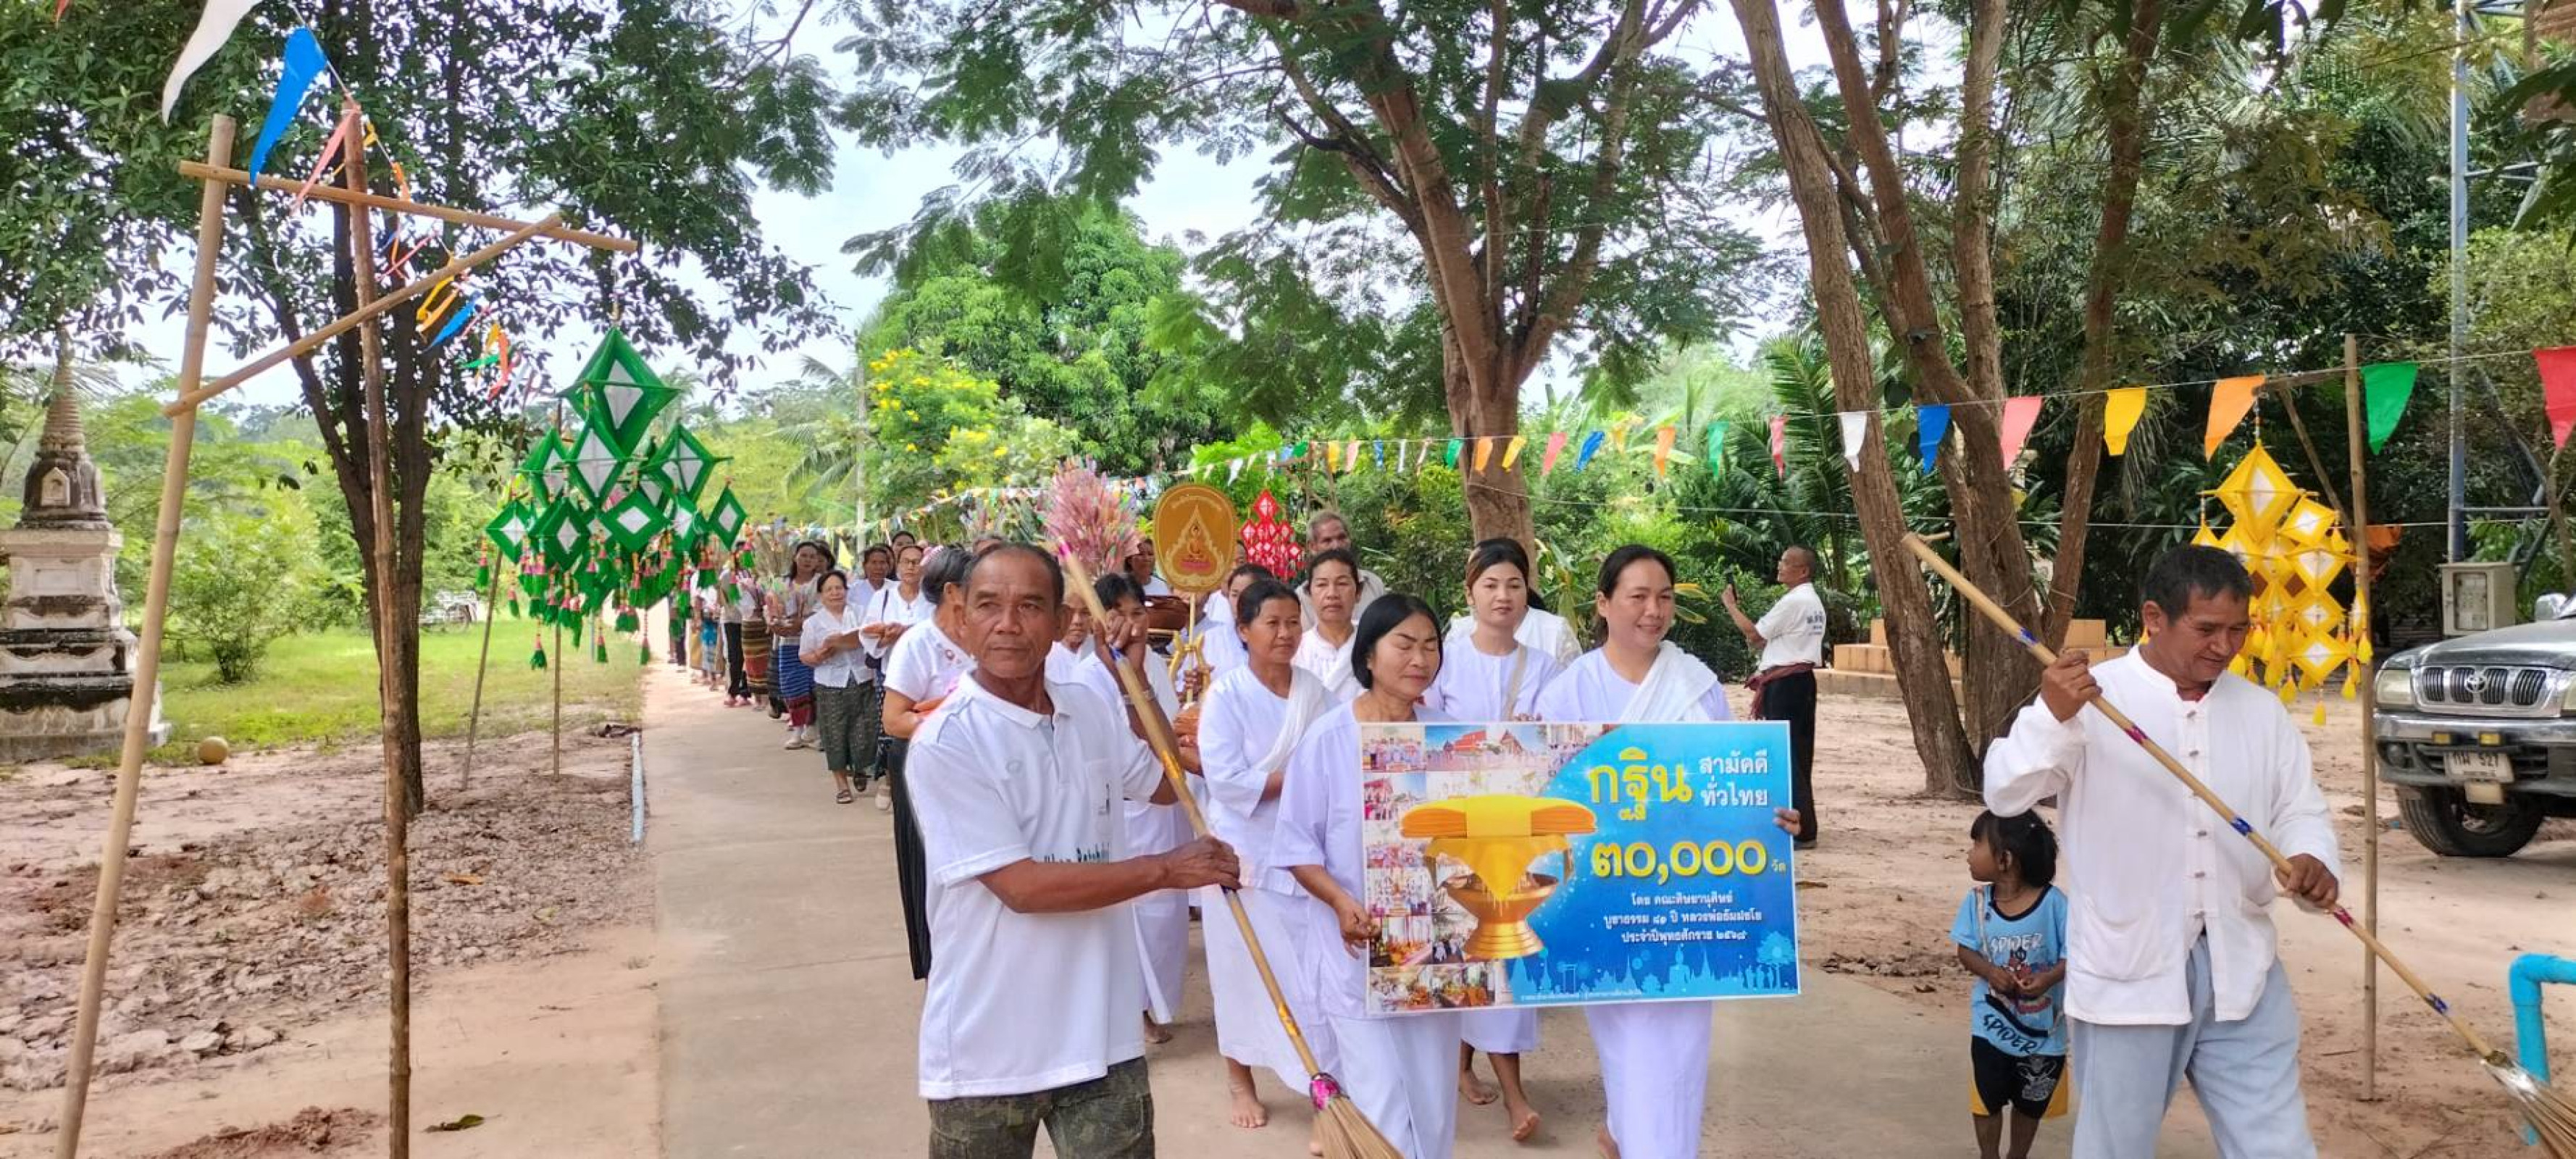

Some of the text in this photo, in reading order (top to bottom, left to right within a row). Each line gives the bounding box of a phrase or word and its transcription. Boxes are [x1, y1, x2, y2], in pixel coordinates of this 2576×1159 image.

[1699, 748, 1768, 774] สามัคคี
[1586, 747, 1693, 821] กฐิน
[1700, 776, 1768, 806] ทั่วไทย
[1592, 840, 1767, 886] ๓๐,๐๐๐
[1631, 892, 1651, 905] โดย
[1603, 914, 1649, 929] บูชาธรรม
[1670, 909, 1678, 924] ปี
[1621, 928, 1713, 946] ประจำปีพุทธศักราช
[1991, 933, 2043, 953] SPIDER
[1983, 1013, 2038, 1054] SPIDER
